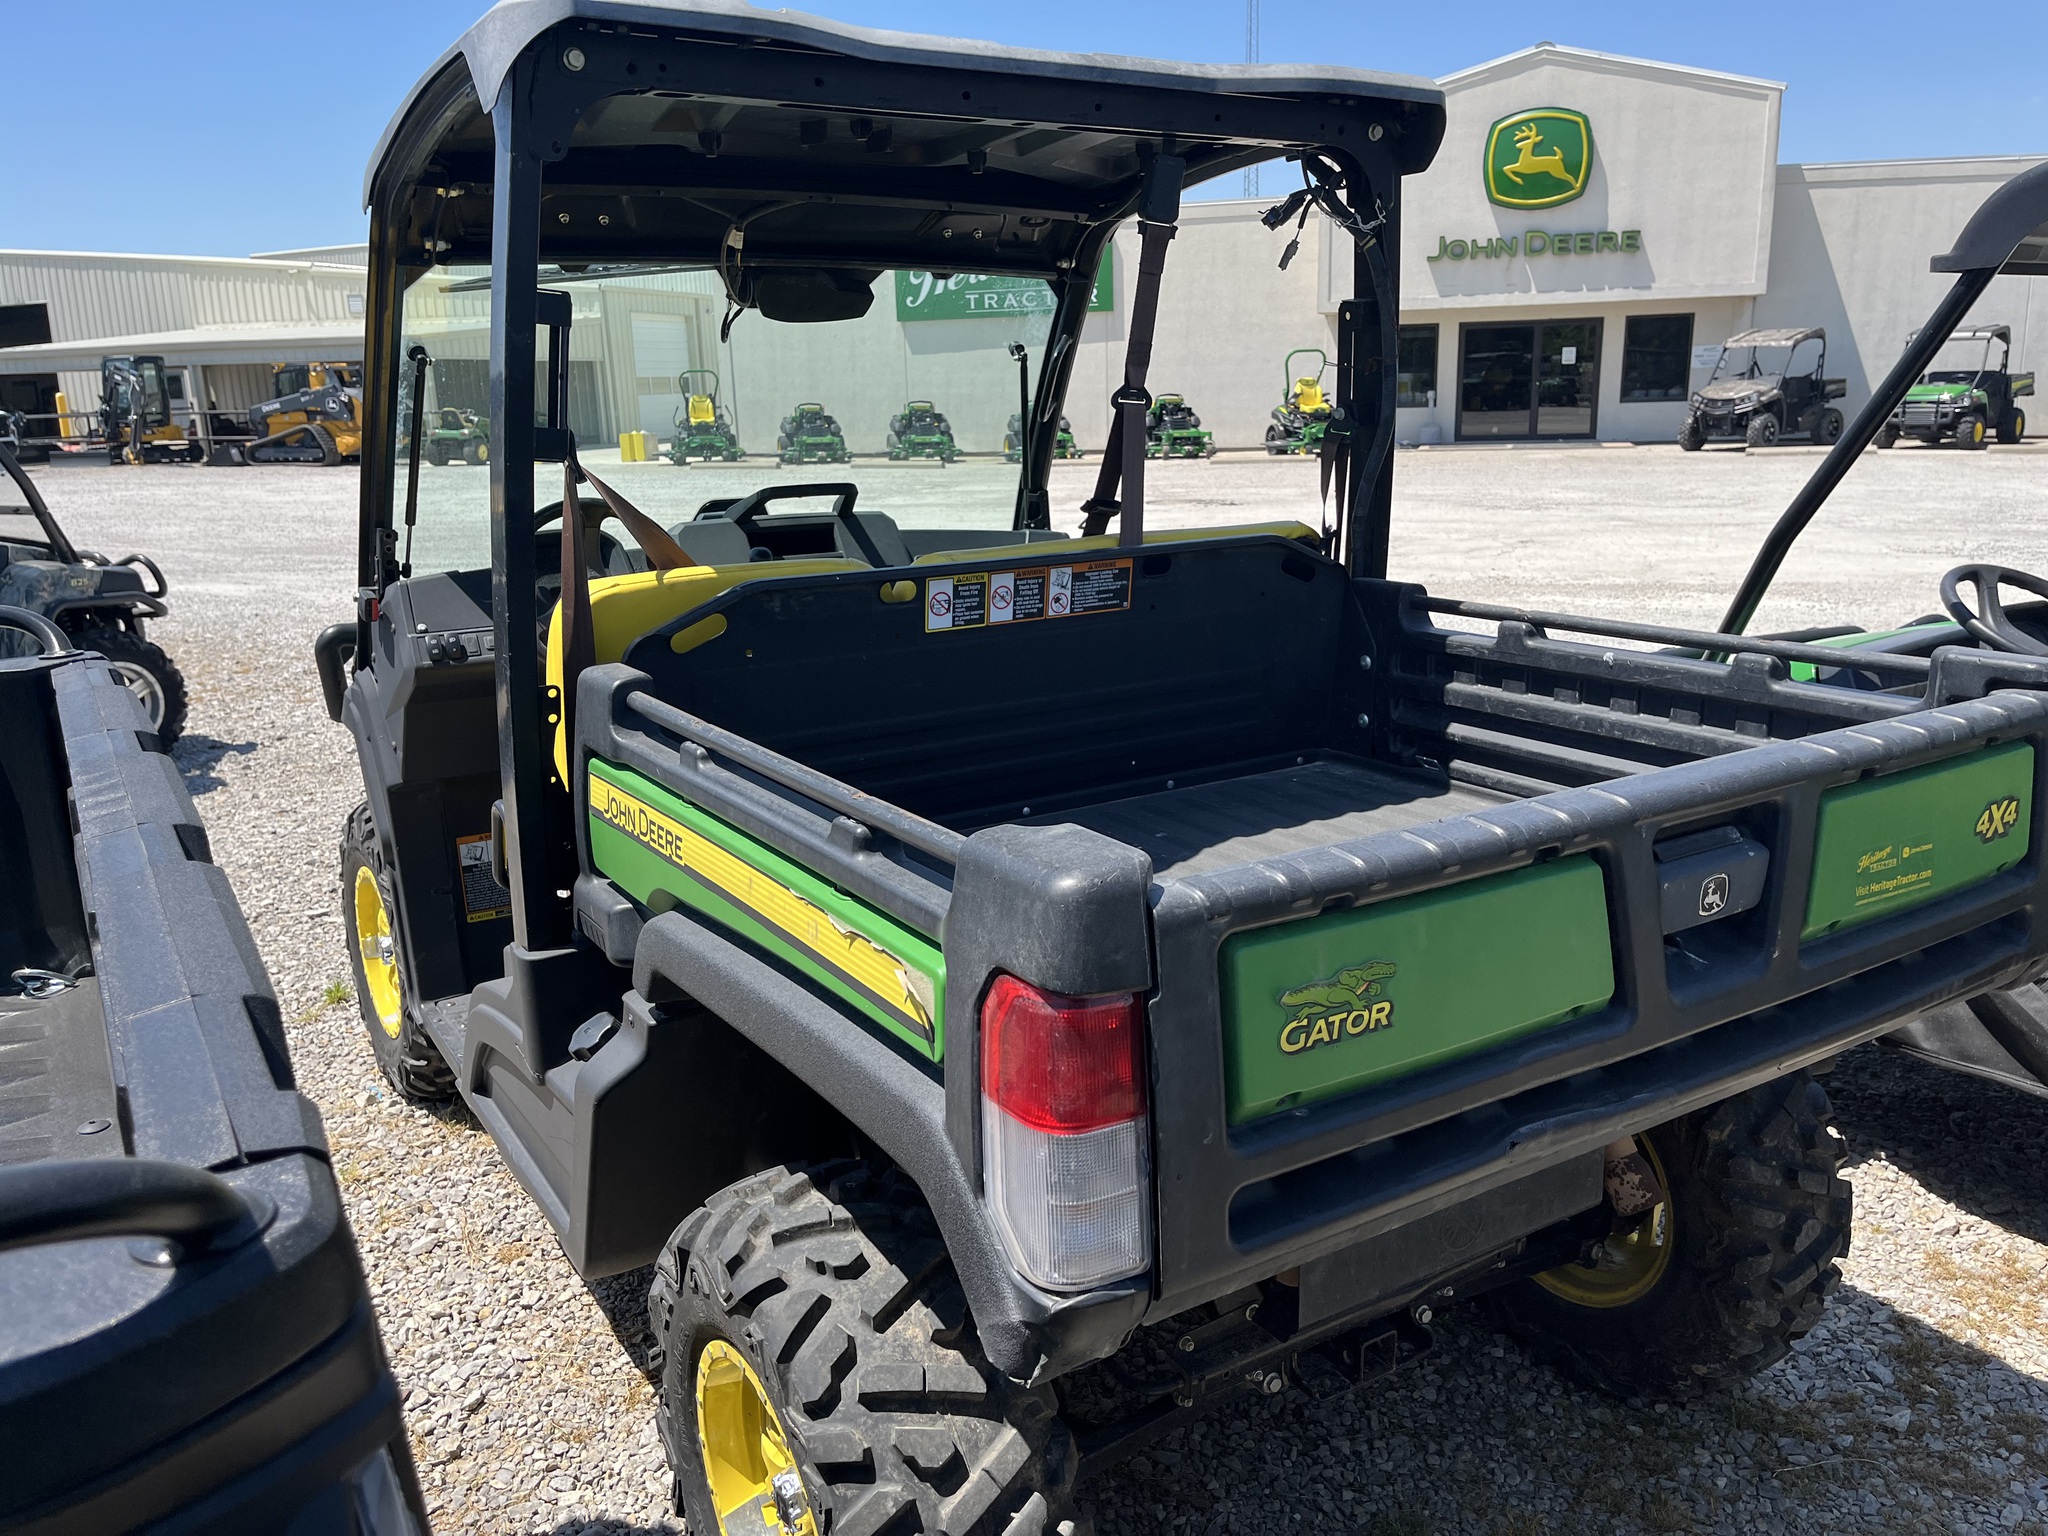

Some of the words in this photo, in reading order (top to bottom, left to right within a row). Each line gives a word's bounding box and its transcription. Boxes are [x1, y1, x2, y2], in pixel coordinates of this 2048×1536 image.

[1427, 236, 1518, 262] JOHN
[1524, 230, 1642, 257] DEERE
[965, 289, 1098, 310] TRACTR
[962, 574, 985, 583] CAUTION
[1022, 568, 1046, 577] WARNING
[603, 789, 637, 832] JOHN
[639, 807, 684, 862] DEERE
[1975, 799, 2019, 840] 4X4
[1857, 845, 1893, 874] Heritage
[1855, 885, 1870, 897] Visit
[1870, 869, 1932, 893] HeritageTractor.com
[1280, 1001, 1392, 1053] GATOR
